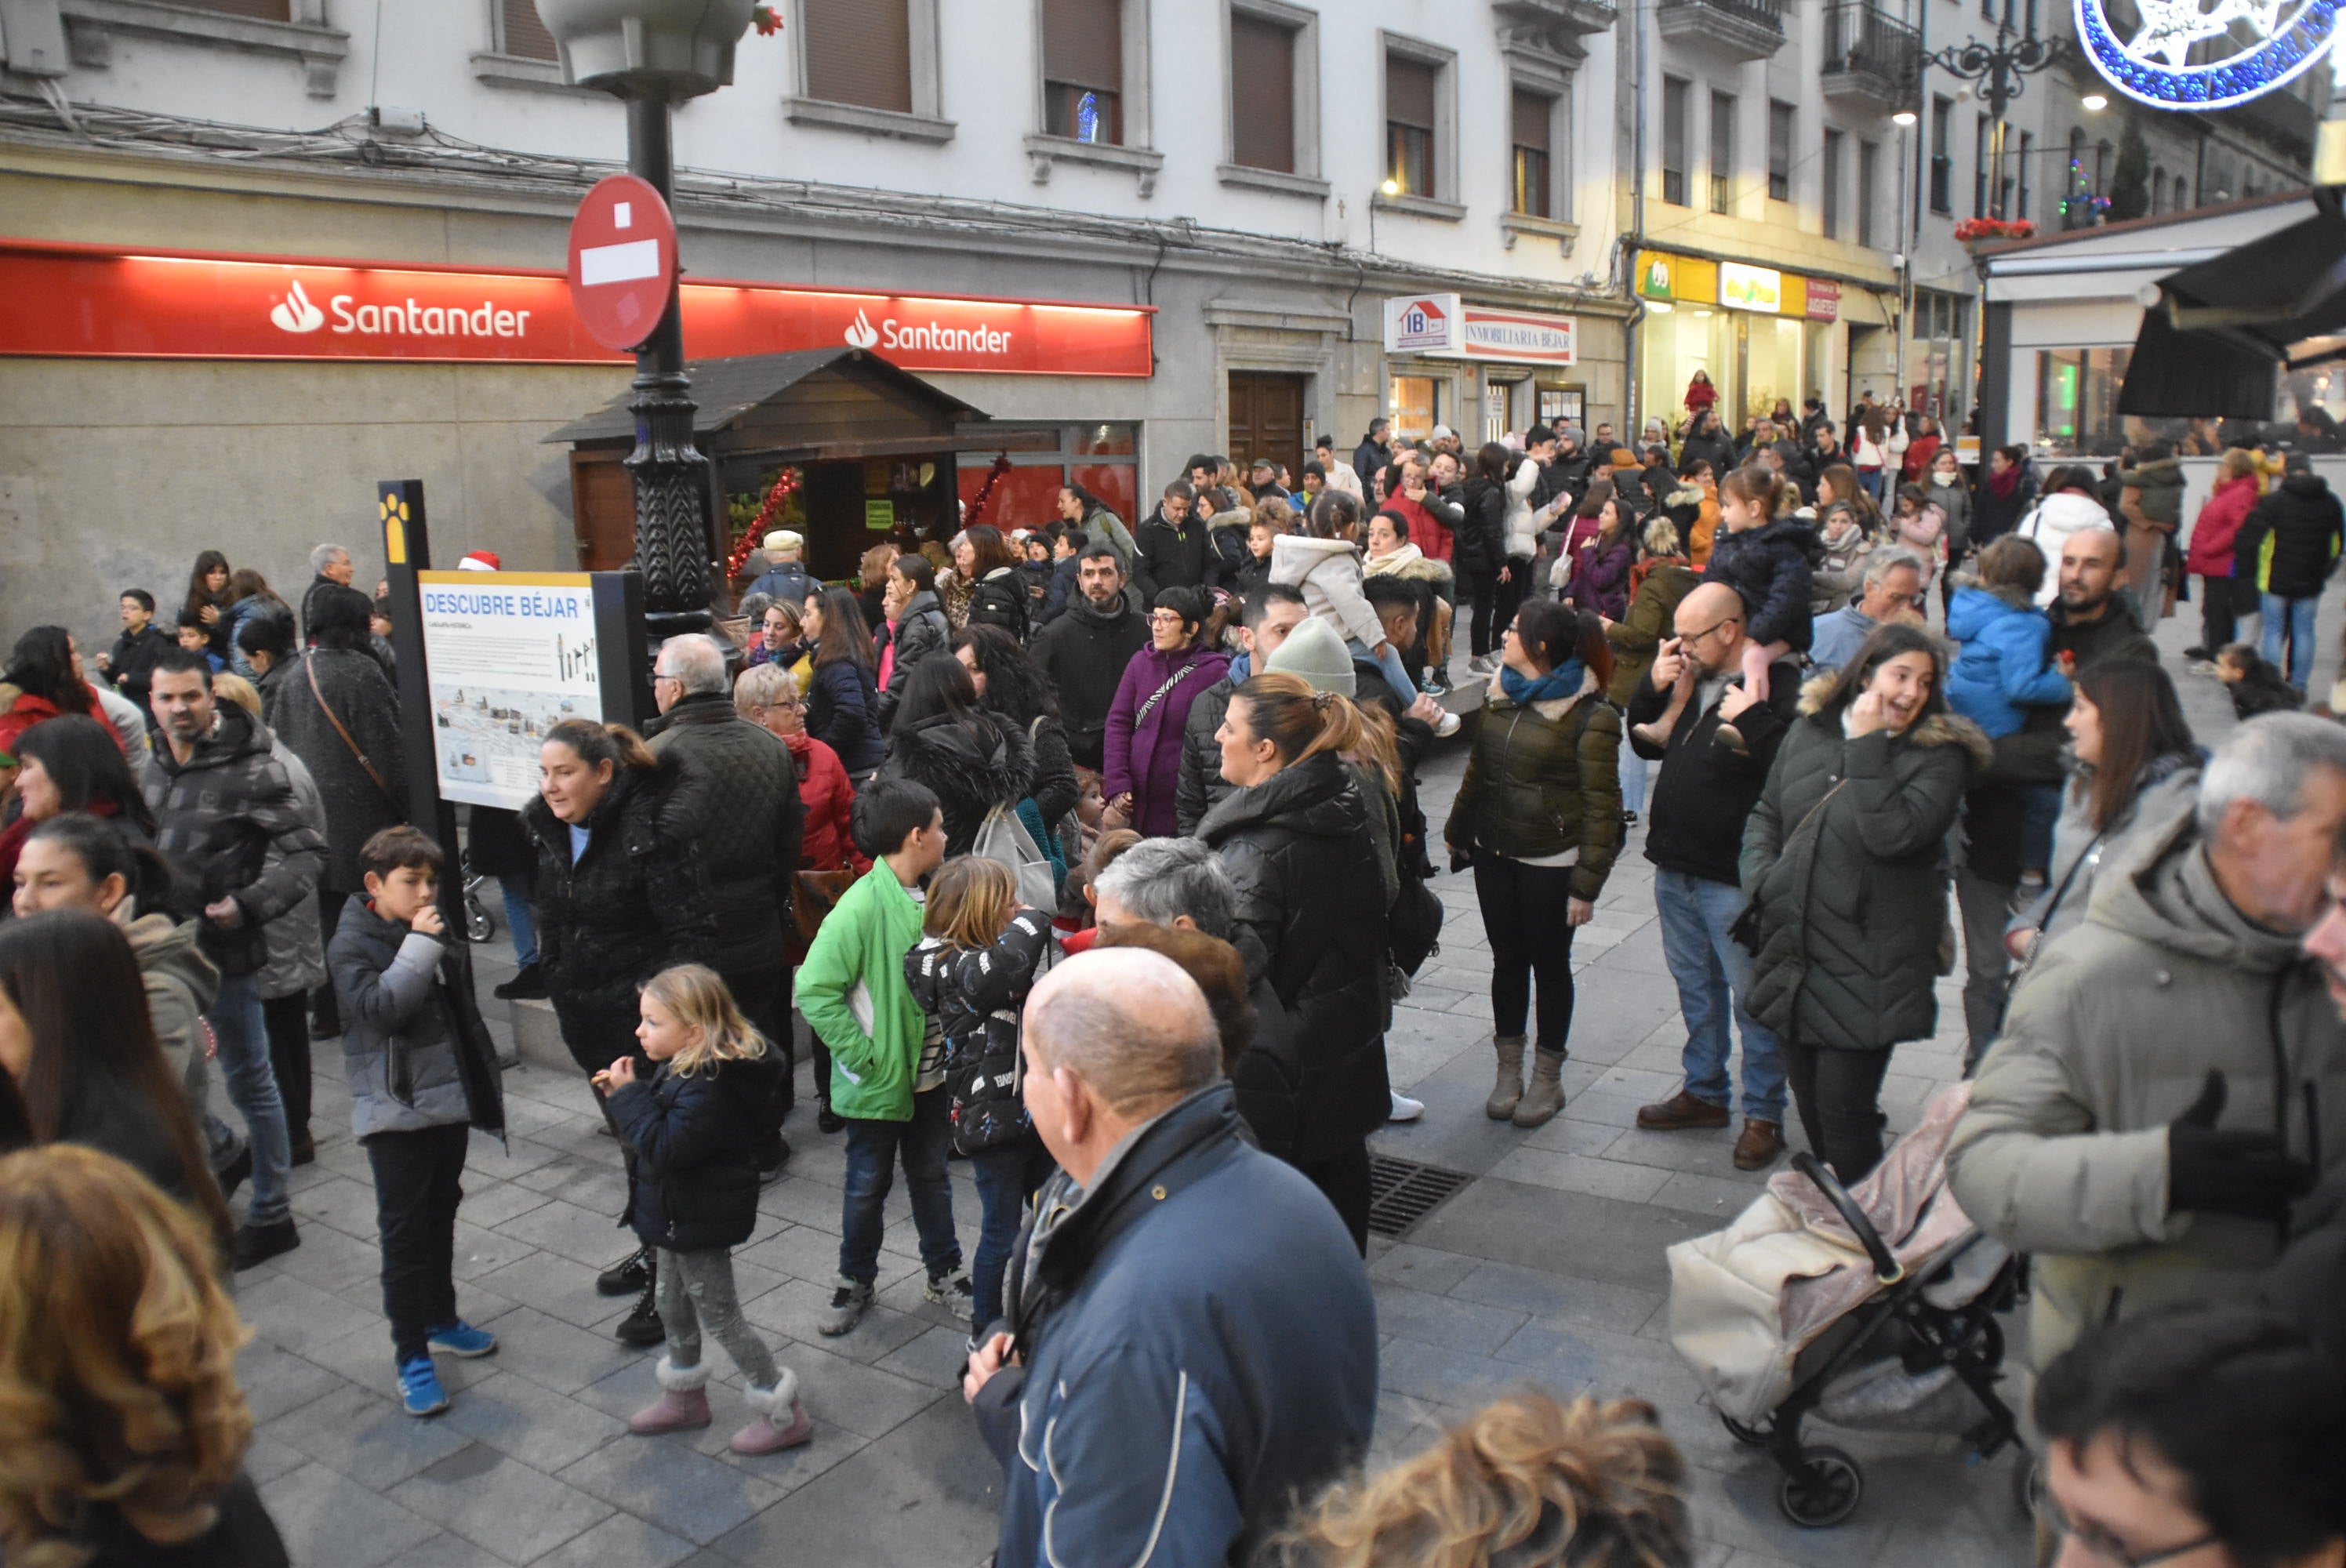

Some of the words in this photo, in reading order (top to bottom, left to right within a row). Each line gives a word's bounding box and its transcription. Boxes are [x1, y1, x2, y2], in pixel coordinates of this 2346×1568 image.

[330, 295, 531, 336] Santander
[1407, 314, 1424, 333] IB
[882, 318, 1011, 353] Santander
[1465, 324, 1538, 346] INMOBILIARIA
[426, 593, 516, 616] DESCUBRE
[520, 591, 579, 619] BÉJAR
